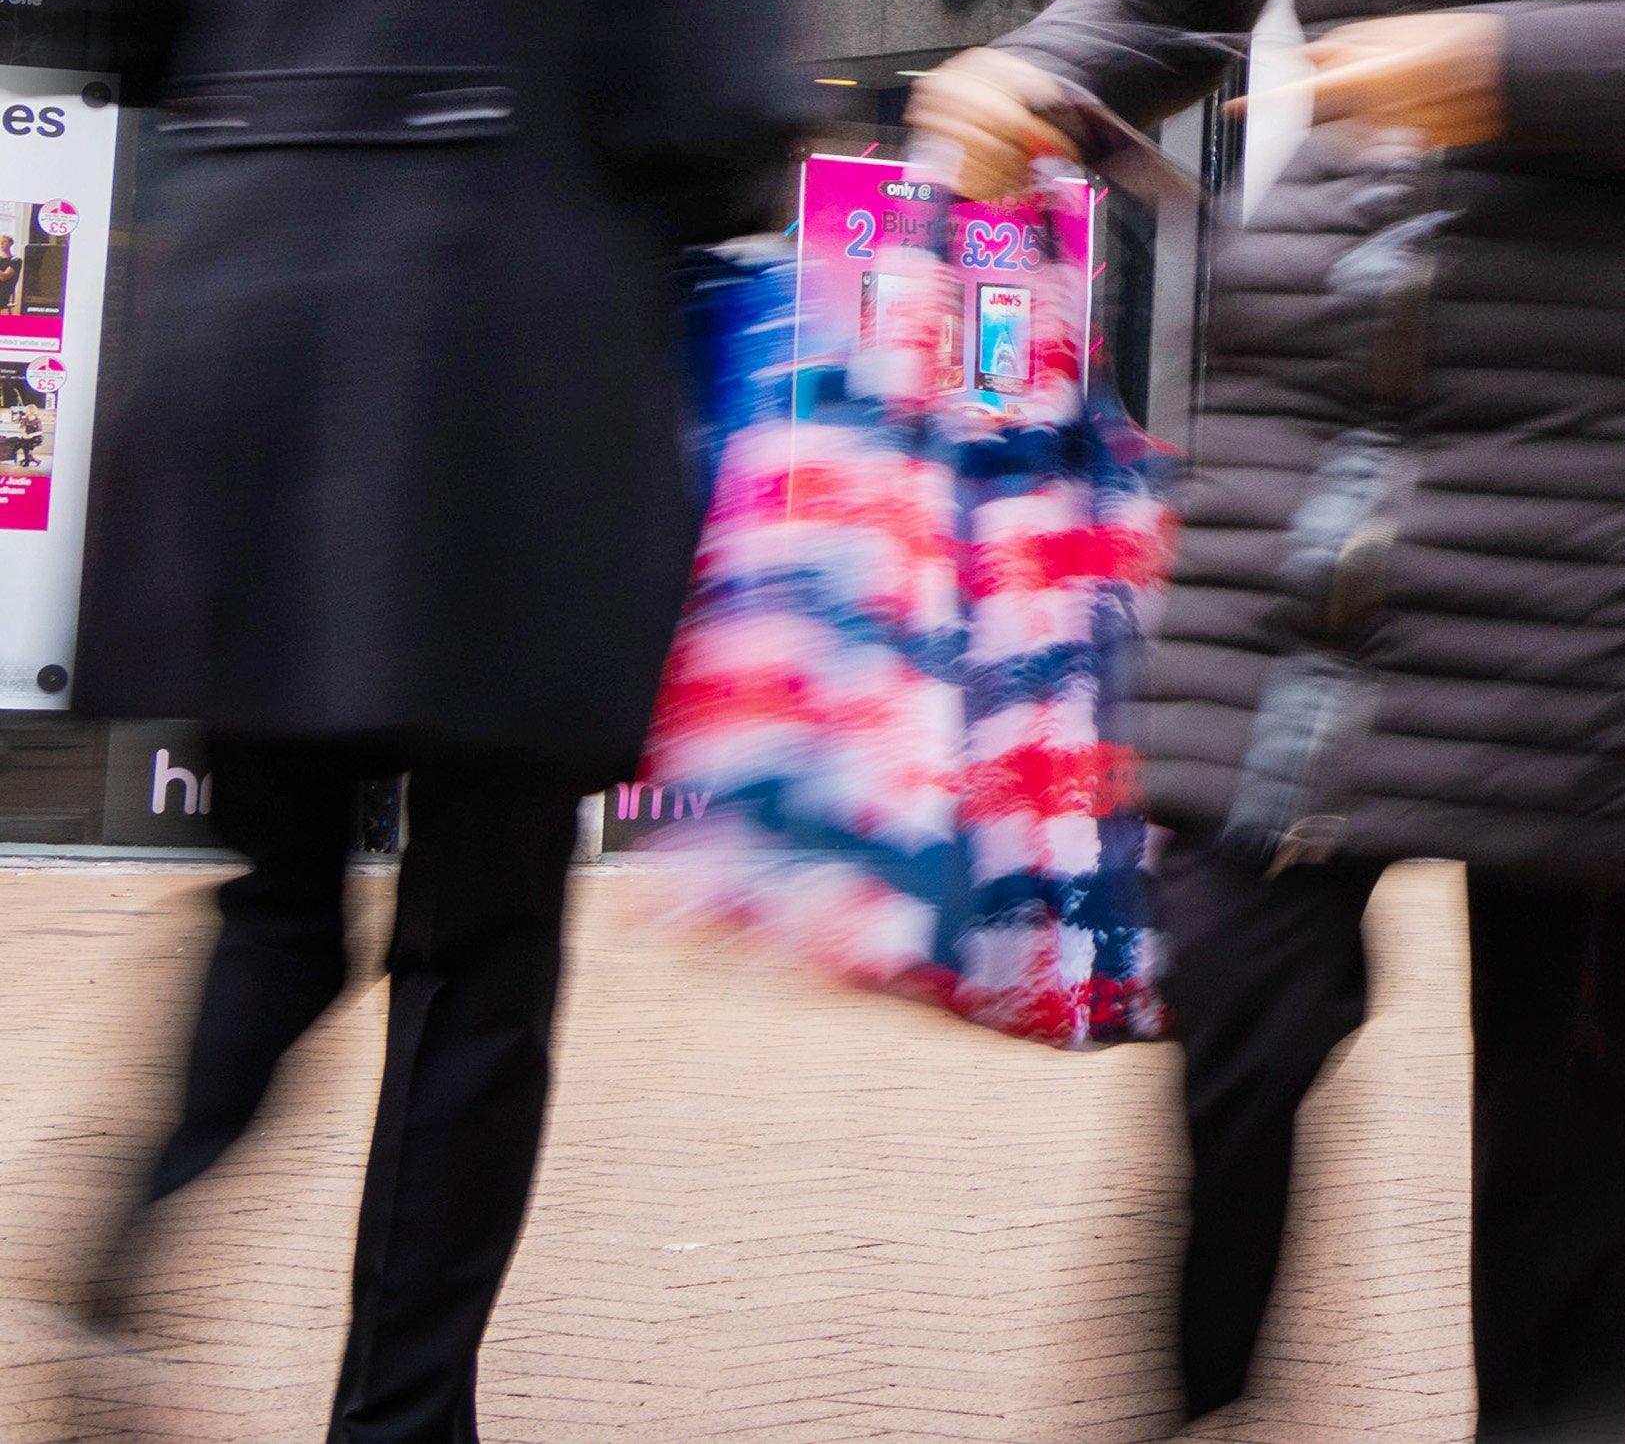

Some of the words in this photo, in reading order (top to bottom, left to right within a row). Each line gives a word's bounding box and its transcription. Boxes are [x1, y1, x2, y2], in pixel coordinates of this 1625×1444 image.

[2, 104, 65, 138] es
[886, 181, 915, 200] only
[917, 184, 932, 200] @
[49, 221, 68, 234] £5
[845, 210, 876, 259] 2
[961, 219, 1048, 273] £25
[989, 291, 1023, 308] JAWS
[35, 378, 56, 391] £5
